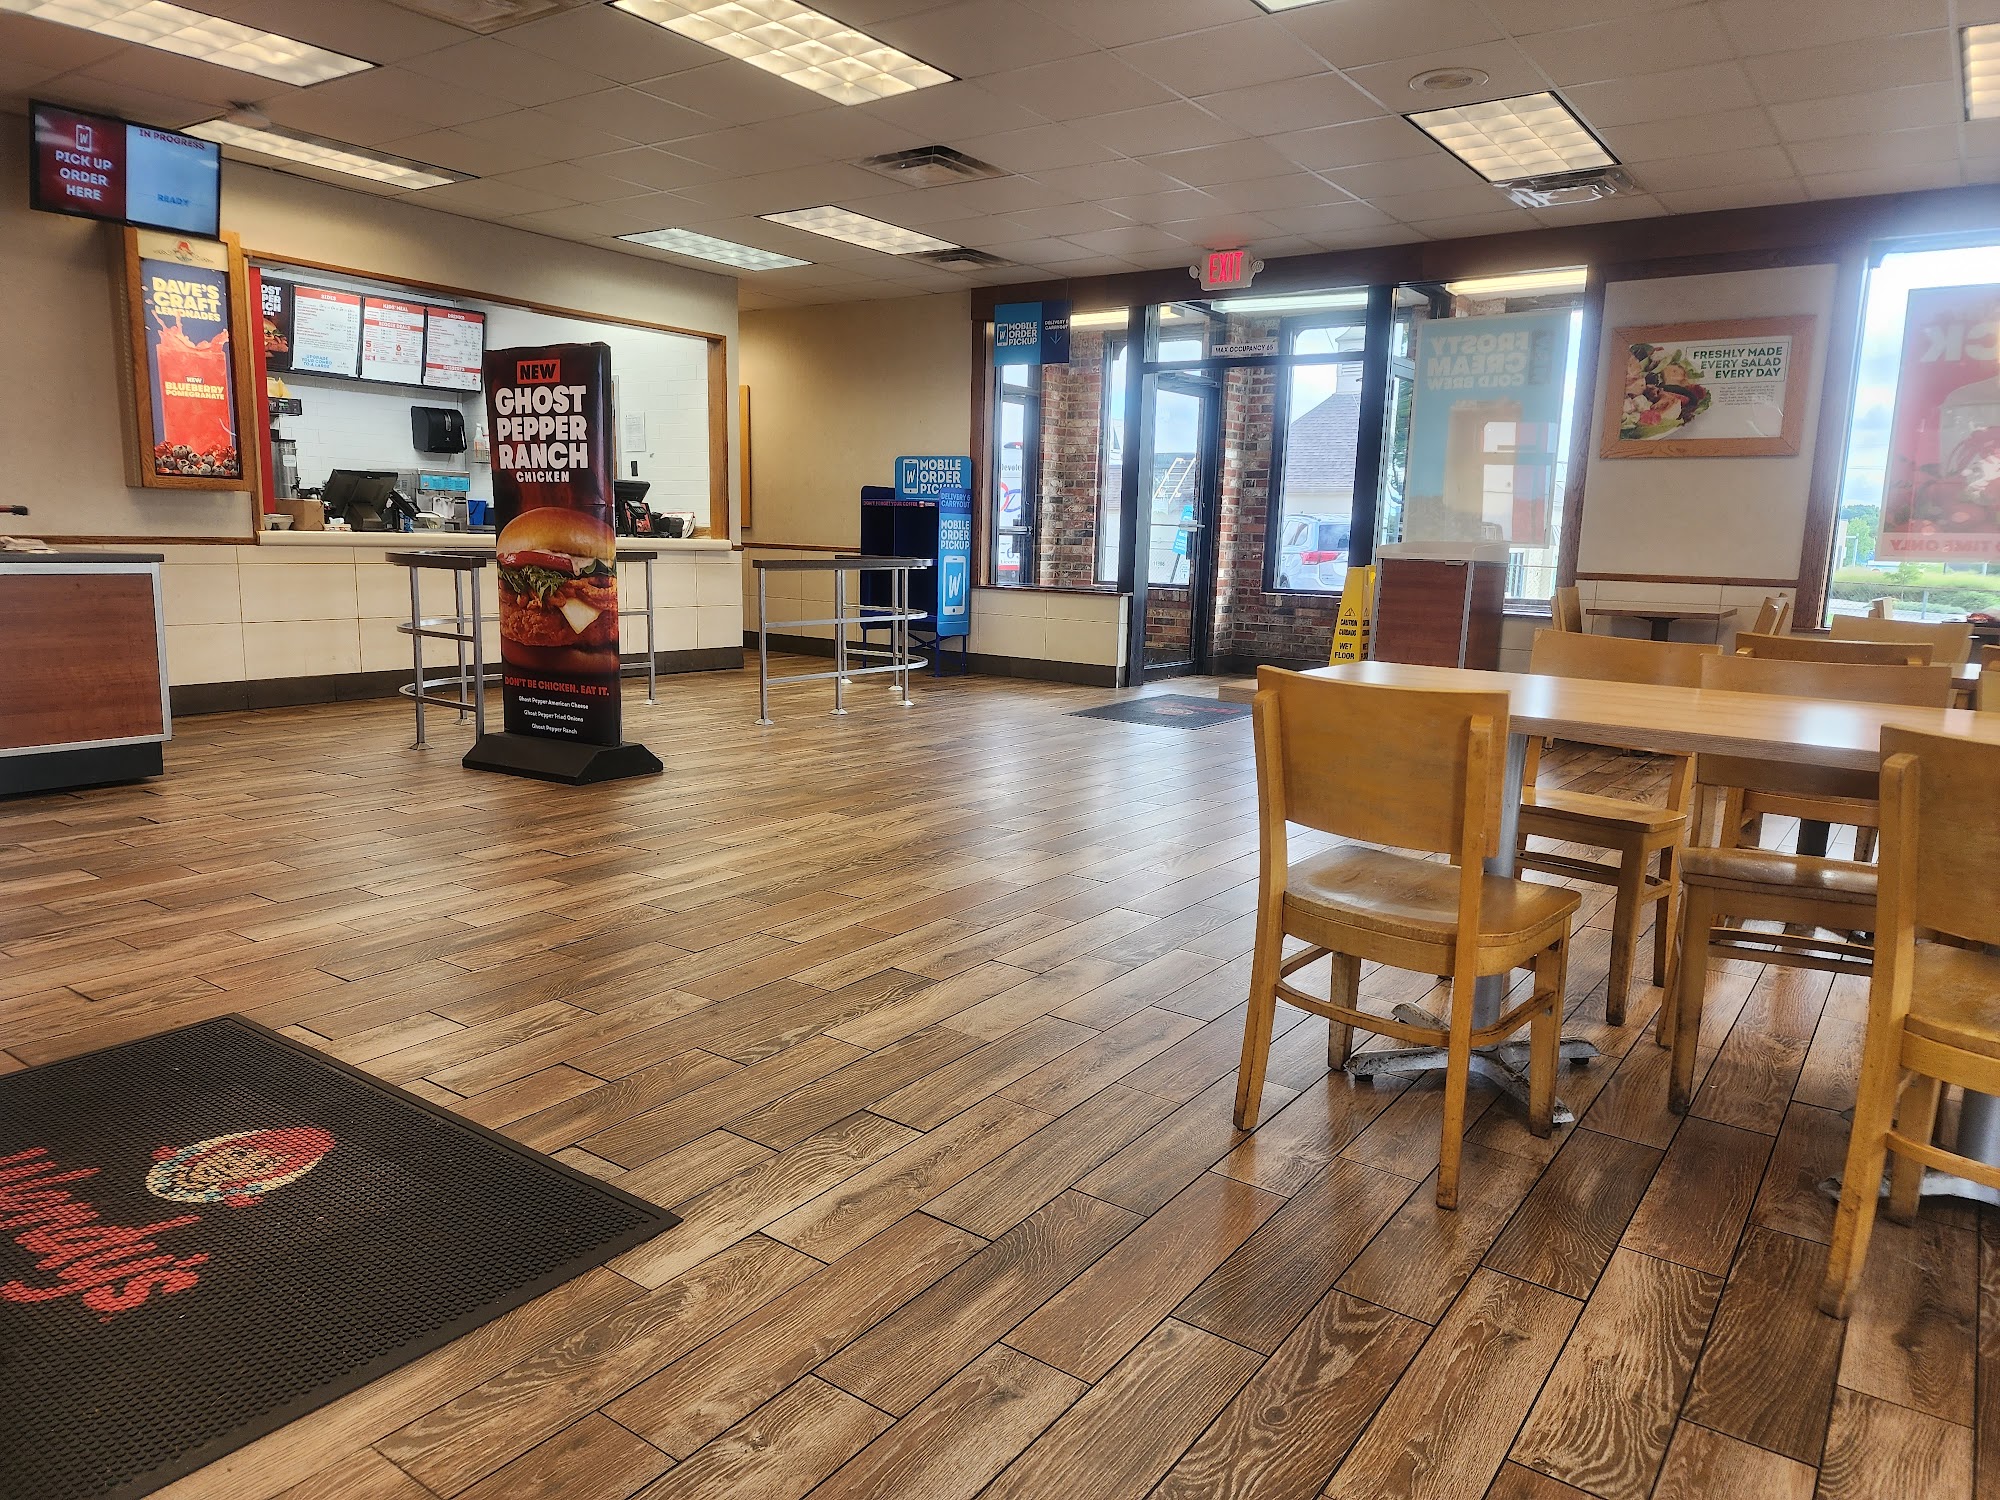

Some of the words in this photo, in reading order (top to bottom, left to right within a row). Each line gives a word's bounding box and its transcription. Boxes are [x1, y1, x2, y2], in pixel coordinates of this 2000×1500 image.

[139, 129, 151, 138] IN
[153, 132, 205, 150] PROGRESS
[55, 150, 90, 167] PICK
[93, 158, 113, 171] UP
[60, 168, 109, 187] ORDER
[66, 184, 103, 202] HERE
[157, 194, 191, 207] READY
[1209, 251, 1244, 284] EXIT
[152, 276, 220, 300] DAVE'S
[153, 291, 221, 313] CRAFT
[154, 305, 221, 322] LEMONADES
[1009, 322, 1037, 331] MOBILE
[1009, 330, 1037, 338] ORDER
[1008, 338, 1037, 346] PICKUP
[1230, 344, 1266, 353] OCCUPANCY
[1693, 348, 1746, 360] FRESHLY
[1748, 346, 1782, 357] MADE
[1701, 359, 1738, 370] EVERY
[1741, 357, 1781, 368] SALAD
[520, 364, 556, 380] NEW
[1715, 369, 1753, 379] EVERY
[1755, 367, 1781, 378] DAY
[165, 381, 224, 394] BLUEBERRY
[165, 389, 225, 400] POMEGRANATE
[495, 385, 586, 415] GHOST
[496, 415, 588, 442] PEPPER
[499, 442, 588, 470] RANCH
[919, 459, 961, 472] MOBILE
[516, 471, 570, 482] CHICKEN
[906, 468, 915, 485] W
[919, 470, 961, 483] ORDER
[920, 483, 962, 495] PIC
[941, 492, 966, 501] DELIVERY
[941, 500, 971, 509] CARRYOUT
[941, 520, 970, 531] MOBILE
[941, 530, 970, 541] ORDER
[941, 540, 970, 550] PICKUP
[949, 573, 962, 599] W
[505, 676, 526, 687] DON'T
[528, 679, 537, 688] BE
[538, 681, 578, 693] CHICKEN.
[580, 685, 596, 695] EAT
[598, 686, 610, 696] IT.
[532, 697, 548, 705] Pepper
[548, 699, 570, 707] American
[538, 711, 554, 719] Pepper
[546, 725, 562, 733] Pepper
